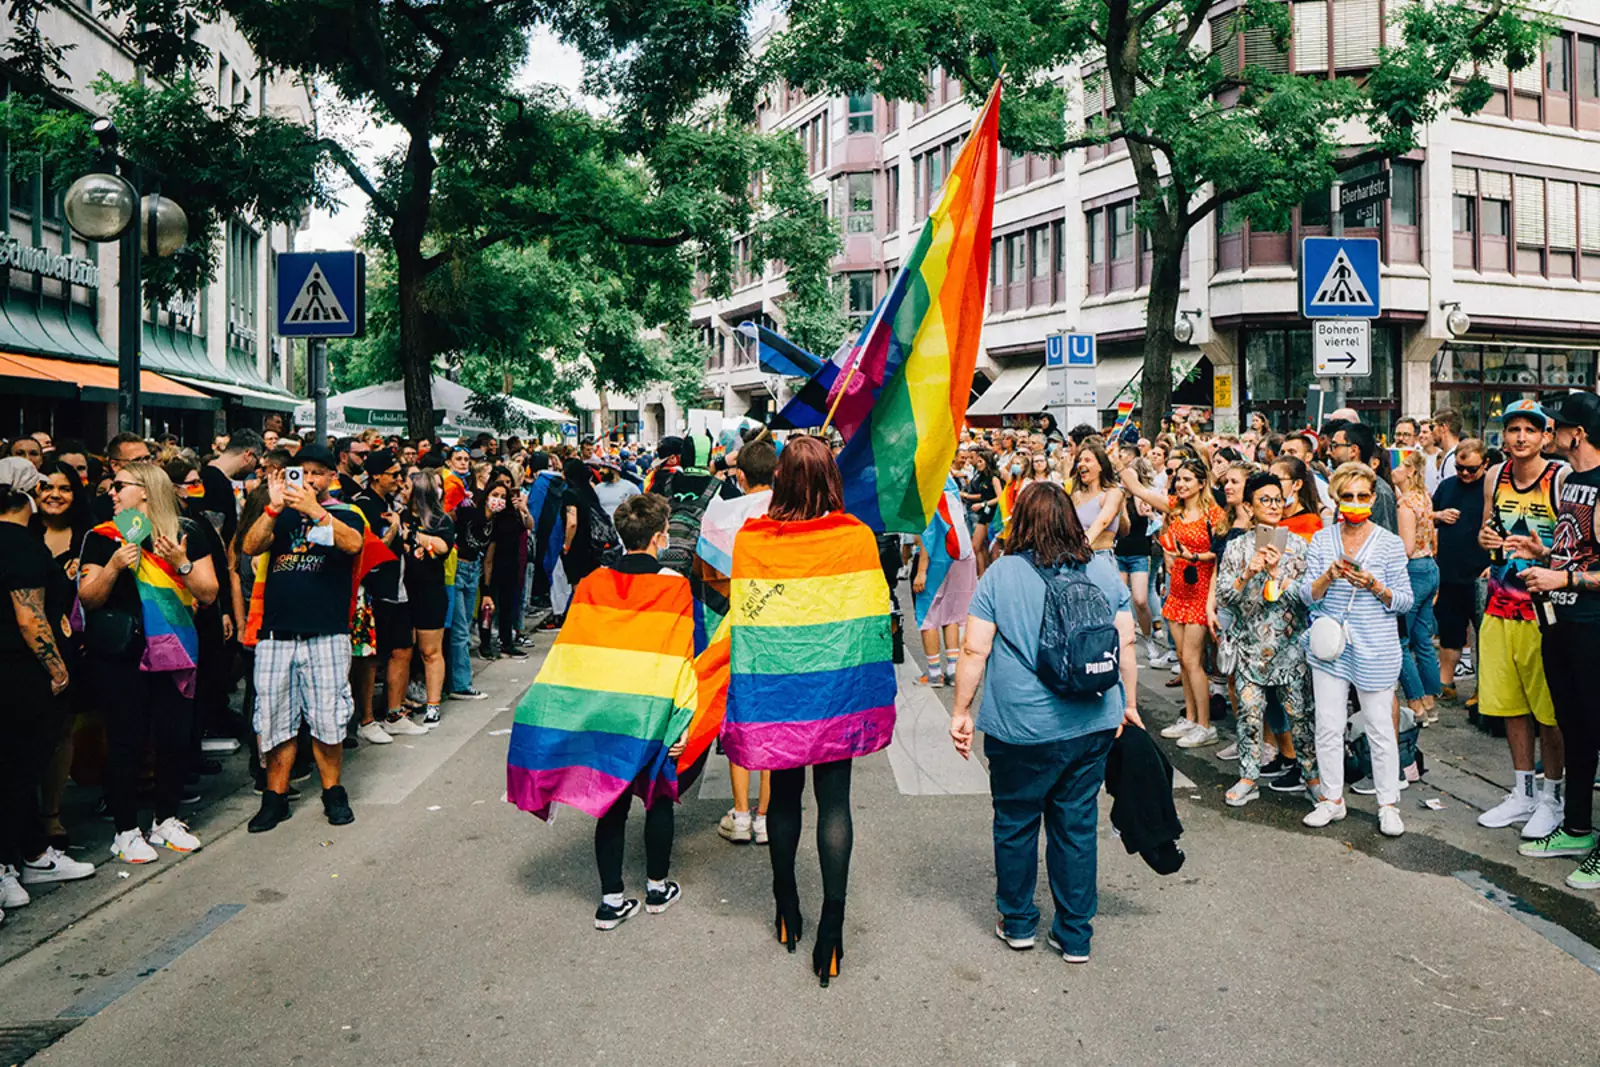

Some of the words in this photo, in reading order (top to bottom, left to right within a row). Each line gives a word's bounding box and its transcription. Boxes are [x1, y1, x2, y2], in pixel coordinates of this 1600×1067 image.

[1342, 179, 1387, 205] Eberhardstr.
[1319, 324, 1365, 335] Bohnen-
[1050, 338, 1060, 358] U
[1072, 337, 1089, 358] U
[1324, 337, 1360, 347] viertel
[1085, 660, 1114, 674] PUMA
